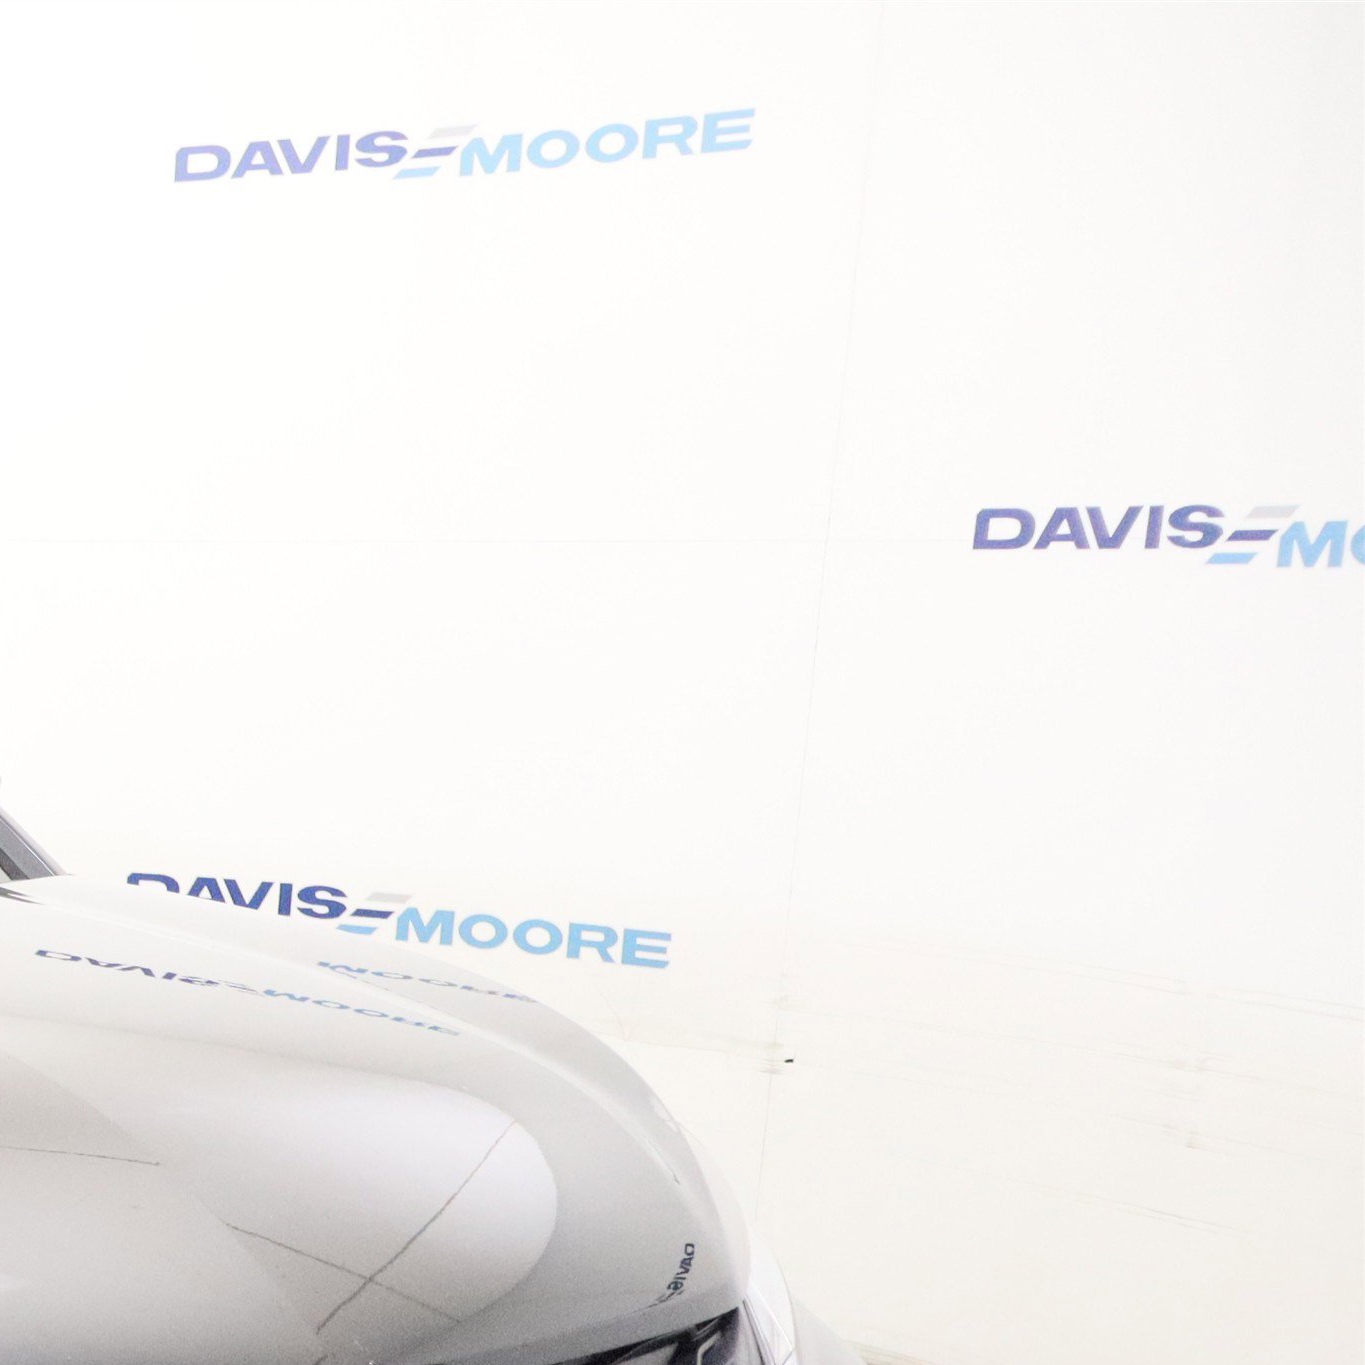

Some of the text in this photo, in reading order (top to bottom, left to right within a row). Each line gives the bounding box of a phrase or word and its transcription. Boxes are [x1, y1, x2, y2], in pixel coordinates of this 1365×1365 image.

[174, 107, 756, 183] DAVIS MOORE
[972, 503, 1223, 550] DAVIS
[395, 907, 673, 970] MOORE
